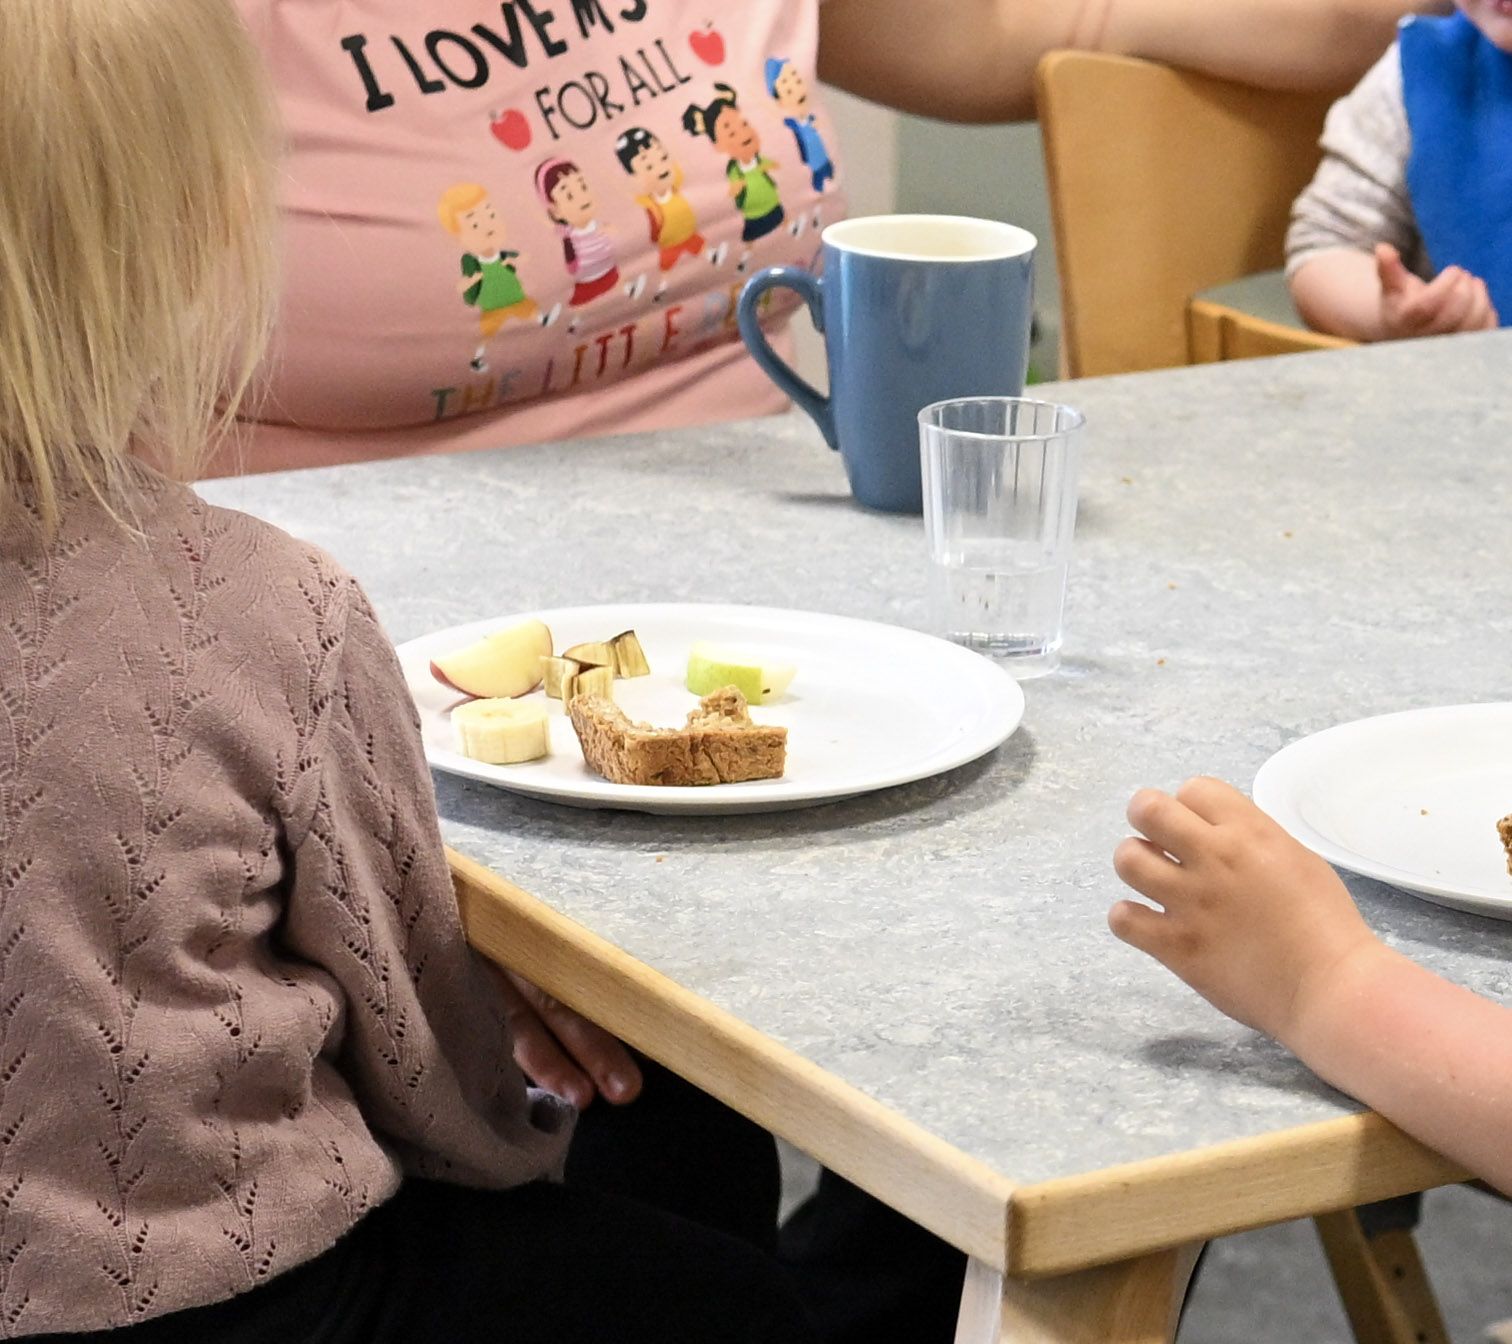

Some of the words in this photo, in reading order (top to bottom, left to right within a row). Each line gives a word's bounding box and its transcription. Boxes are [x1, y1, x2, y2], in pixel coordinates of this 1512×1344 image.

[341, 34, 395, 113] I
[534, 71, 625, 141] FOR
[619, 39, 692, 106] ALL
